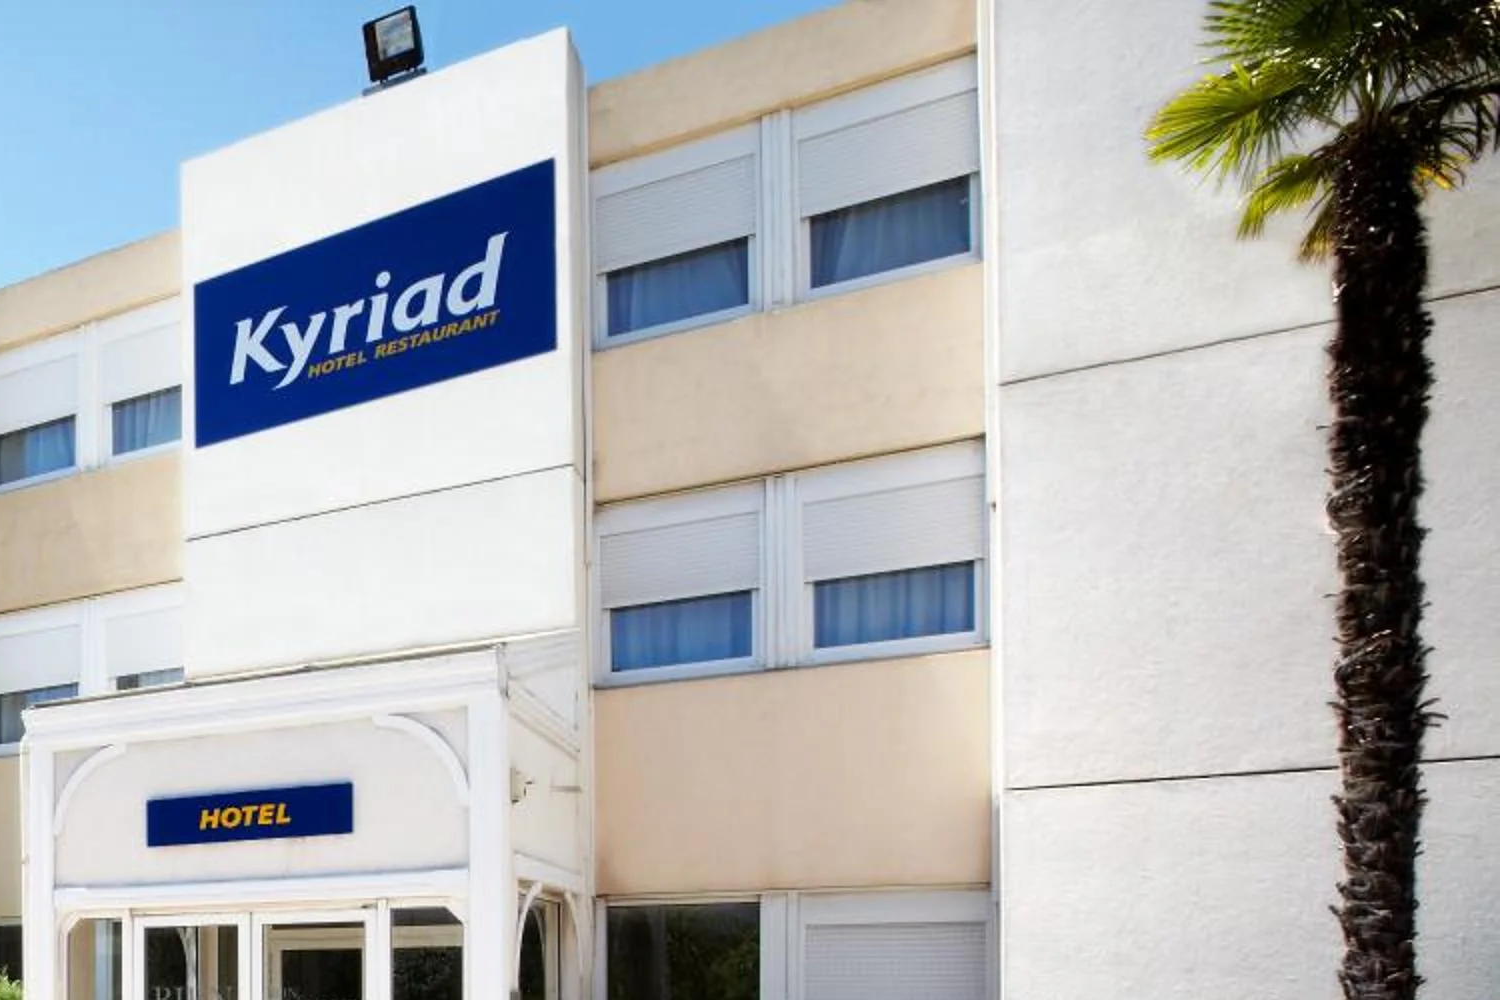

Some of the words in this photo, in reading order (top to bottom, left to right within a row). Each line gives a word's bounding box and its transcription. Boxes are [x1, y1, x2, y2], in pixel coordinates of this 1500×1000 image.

[229, 230, 510, 391] Kyriad
[308, 351, 368, 378] HOTEL
[374, 309, 500, 359] RESTAURANT
[199, 803, 291, 830] HOTEL
